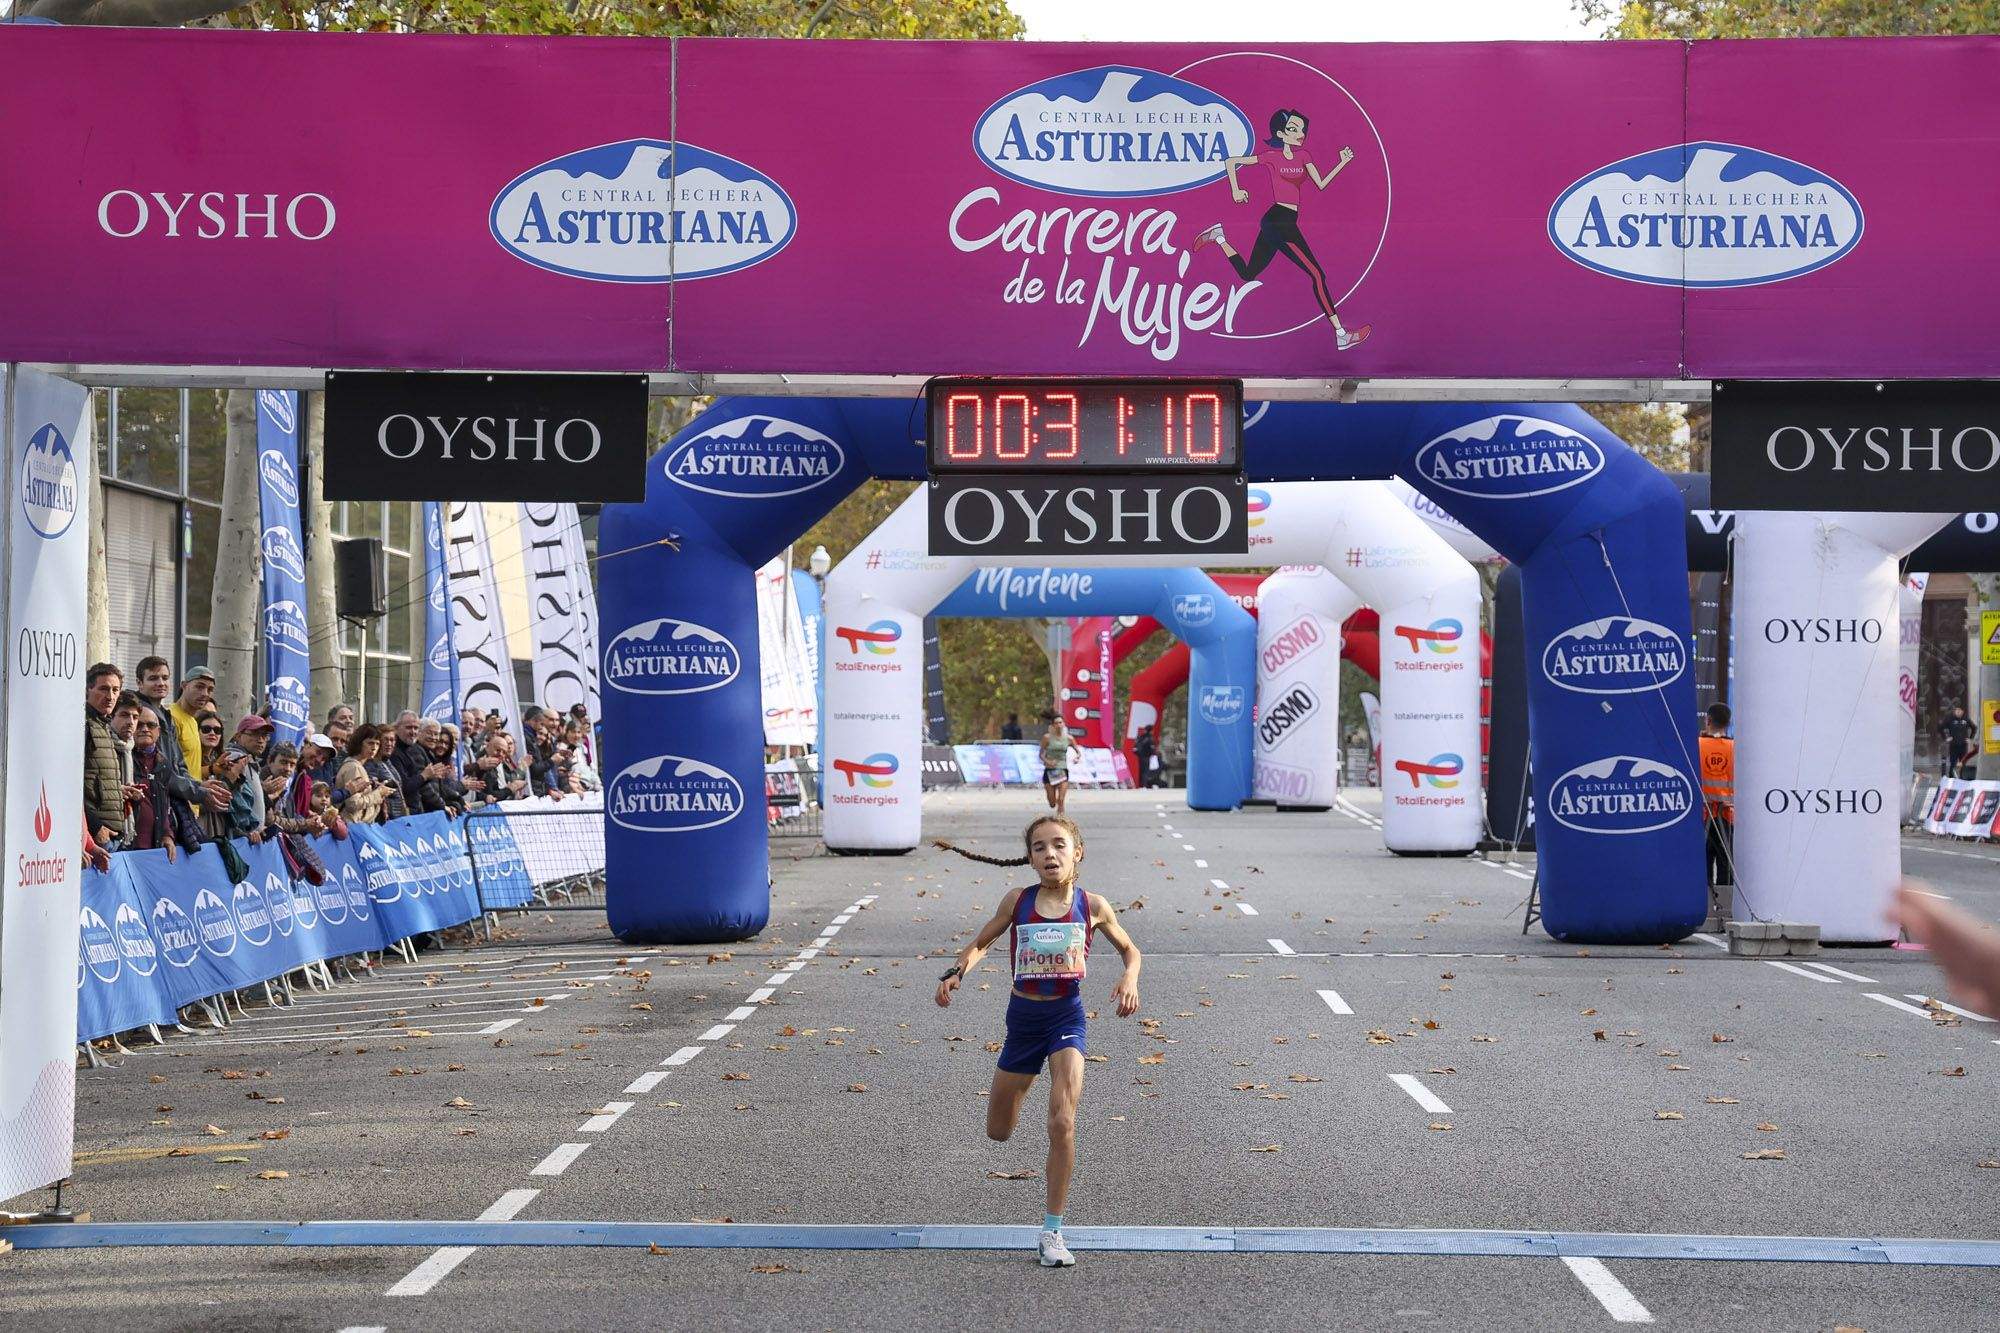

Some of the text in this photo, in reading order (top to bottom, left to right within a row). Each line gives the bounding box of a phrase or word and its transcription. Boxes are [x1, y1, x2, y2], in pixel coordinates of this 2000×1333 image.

[1039, 111, 1224, 123] CENTRAL LECHERA
[995, 113, 1231, 162] ASTURIANA
[561, 188, 763, 202] CENTRAL LECHERA
[1622, 192, 1829, 206] CENTRAL LECHERA
[97, 189, 338, 241] OYSHO
[513, 191, 774, 244] ASTURIANA
[949, 187, 1178, 255] Carrera
[1572, 195, 1839, 248] ASTURIANA
[1003, 249, 1264, 361] de la Mujer
[377, 413, 602, 463] OYSHO
[948, 393, 1221, 458] 00:31:10
[675, 447, 830, 476] ASTURIANA
[705, 442, 827, 453] CENTRAL LECHERA
[1454, 440, 1583, 456] CENTRAL LECHERA
[1766, 426, 2000, 472] OYSHO
[1432, 450, 1594, 480] ASTURIANA
[24, 461, 73, 513] ASTURIANA
[944, 486, 1232, 545] OYSHO
[974, 565, 1094, 611] Marlene
[1765, 618, 1882, 644] OYSHO
[19, 627, 76, 681] OYSHO
[625, 644, 726, 654] CENTRAL LECHERA
[1263, 621, 1318, 673] COSMO
[1572, 641, 1675, 653] CENTRAL LECHERA
[610, 650, 732, 679] ASTURIANA
[835, 662, 902, 674] TotalEnergies
[1394, 660, 1464, 673] TotalEnergies
[1552, 648, 1680, 677] ASTURIANA
[834, 711, 901, 722] totalenergies.es
[1260, 689, 1312, 745] COSMO
[1394, 711, 1465, 721] totalenergies.es
[1710, 756, 1723, 766] BP
[613, 786, 735, 815] ASTURIANA
[628, 781, 730, 791] CENTRAL LECHERA
[833, 795, 899, 806] TotalEnergies
[1578, 780, 1682, 792] CENTRAL LECHERA
[1395, 796, 1465, 808] TotalEnergies
[1557, 786, 1686, 816] ASTURIANA
[1765, 788, 1883, 814] OYSHO
[18, 853, 67, 888] Santander
